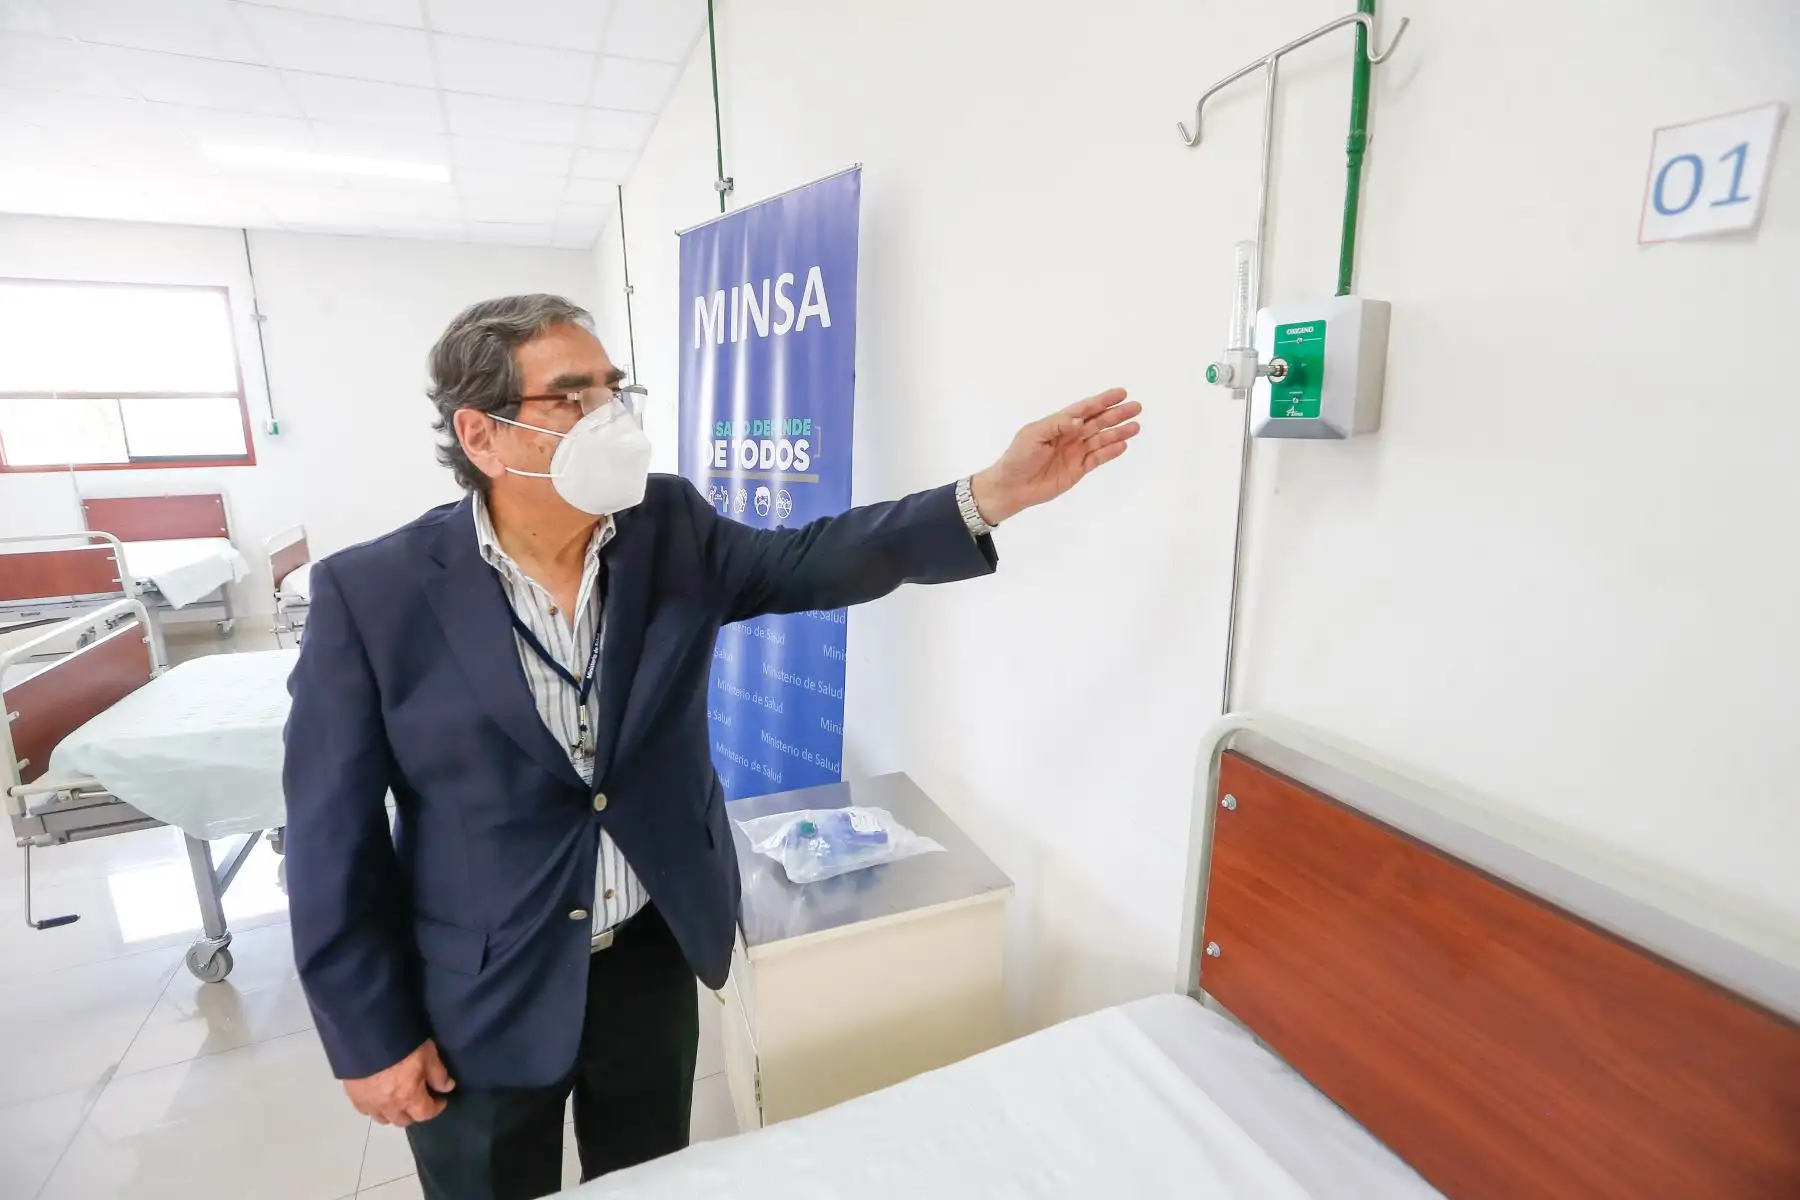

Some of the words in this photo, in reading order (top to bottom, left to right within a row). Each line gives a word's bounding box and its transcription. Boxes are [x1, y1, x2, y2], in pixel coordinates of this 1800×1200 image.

[1652, 140, 1752, 217] 01
[694, 265, 832, 349] MINSA
[753, 418, 812, 436] DENDE
[731, 438, 811, 472] TODOS
[753, 625, 765, 638] de
[803, 676, 816, 691] de
[817, 680, 843, 699] Salud
[752, 692, 763, 705] de
[764, 695, 783, 714] Salud
[761, 729, 800, 757] Ministerio
[801, 748, 813, 762] de
[815, 753, 840, 774] Salud
[750, 759, 761, 773] de
[762, 764, 782, 784] Salud
